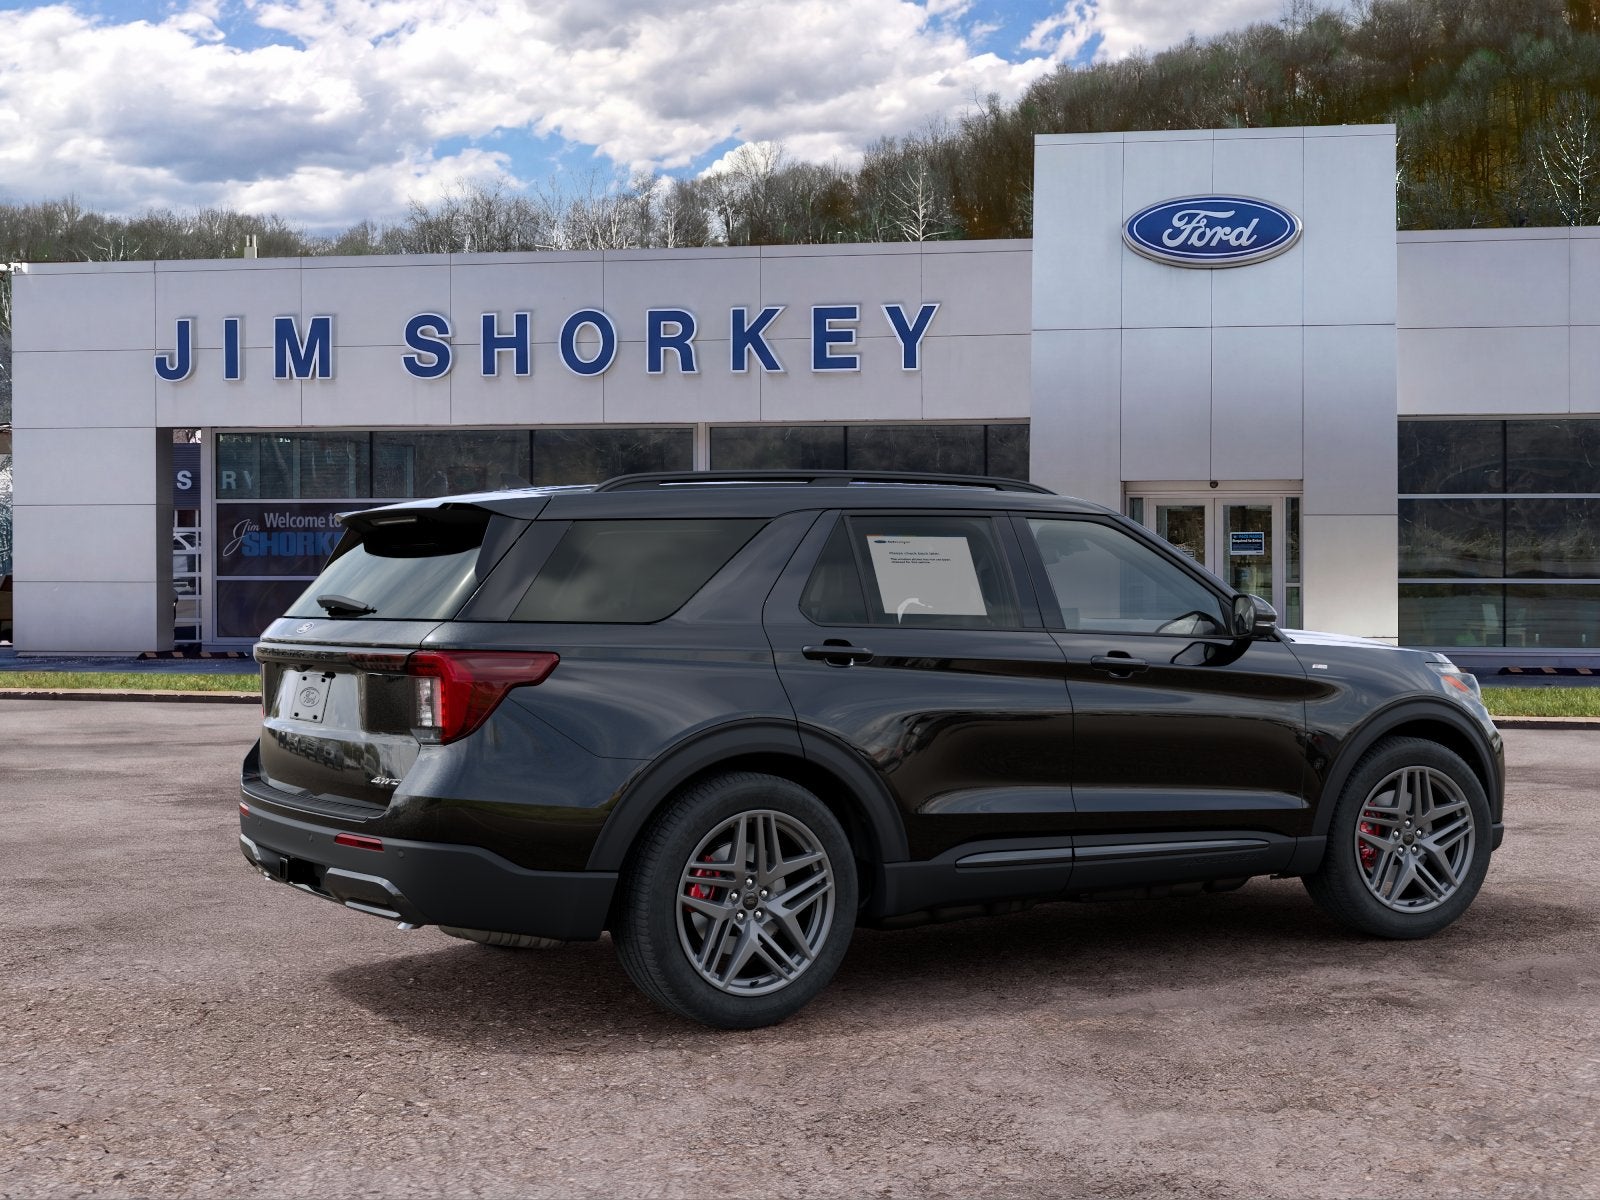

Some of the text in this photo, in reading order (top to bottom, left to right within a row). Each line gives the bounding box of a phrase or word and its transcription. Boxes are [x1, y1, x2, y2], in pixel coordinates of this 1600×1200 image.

[1162, 209, 1260, 248] Ford
[153, 302, 942, 383] JIM SHORKEY
[223, 518, 260, 557] Jim
[264, 512, 342, 529] Welcome to
